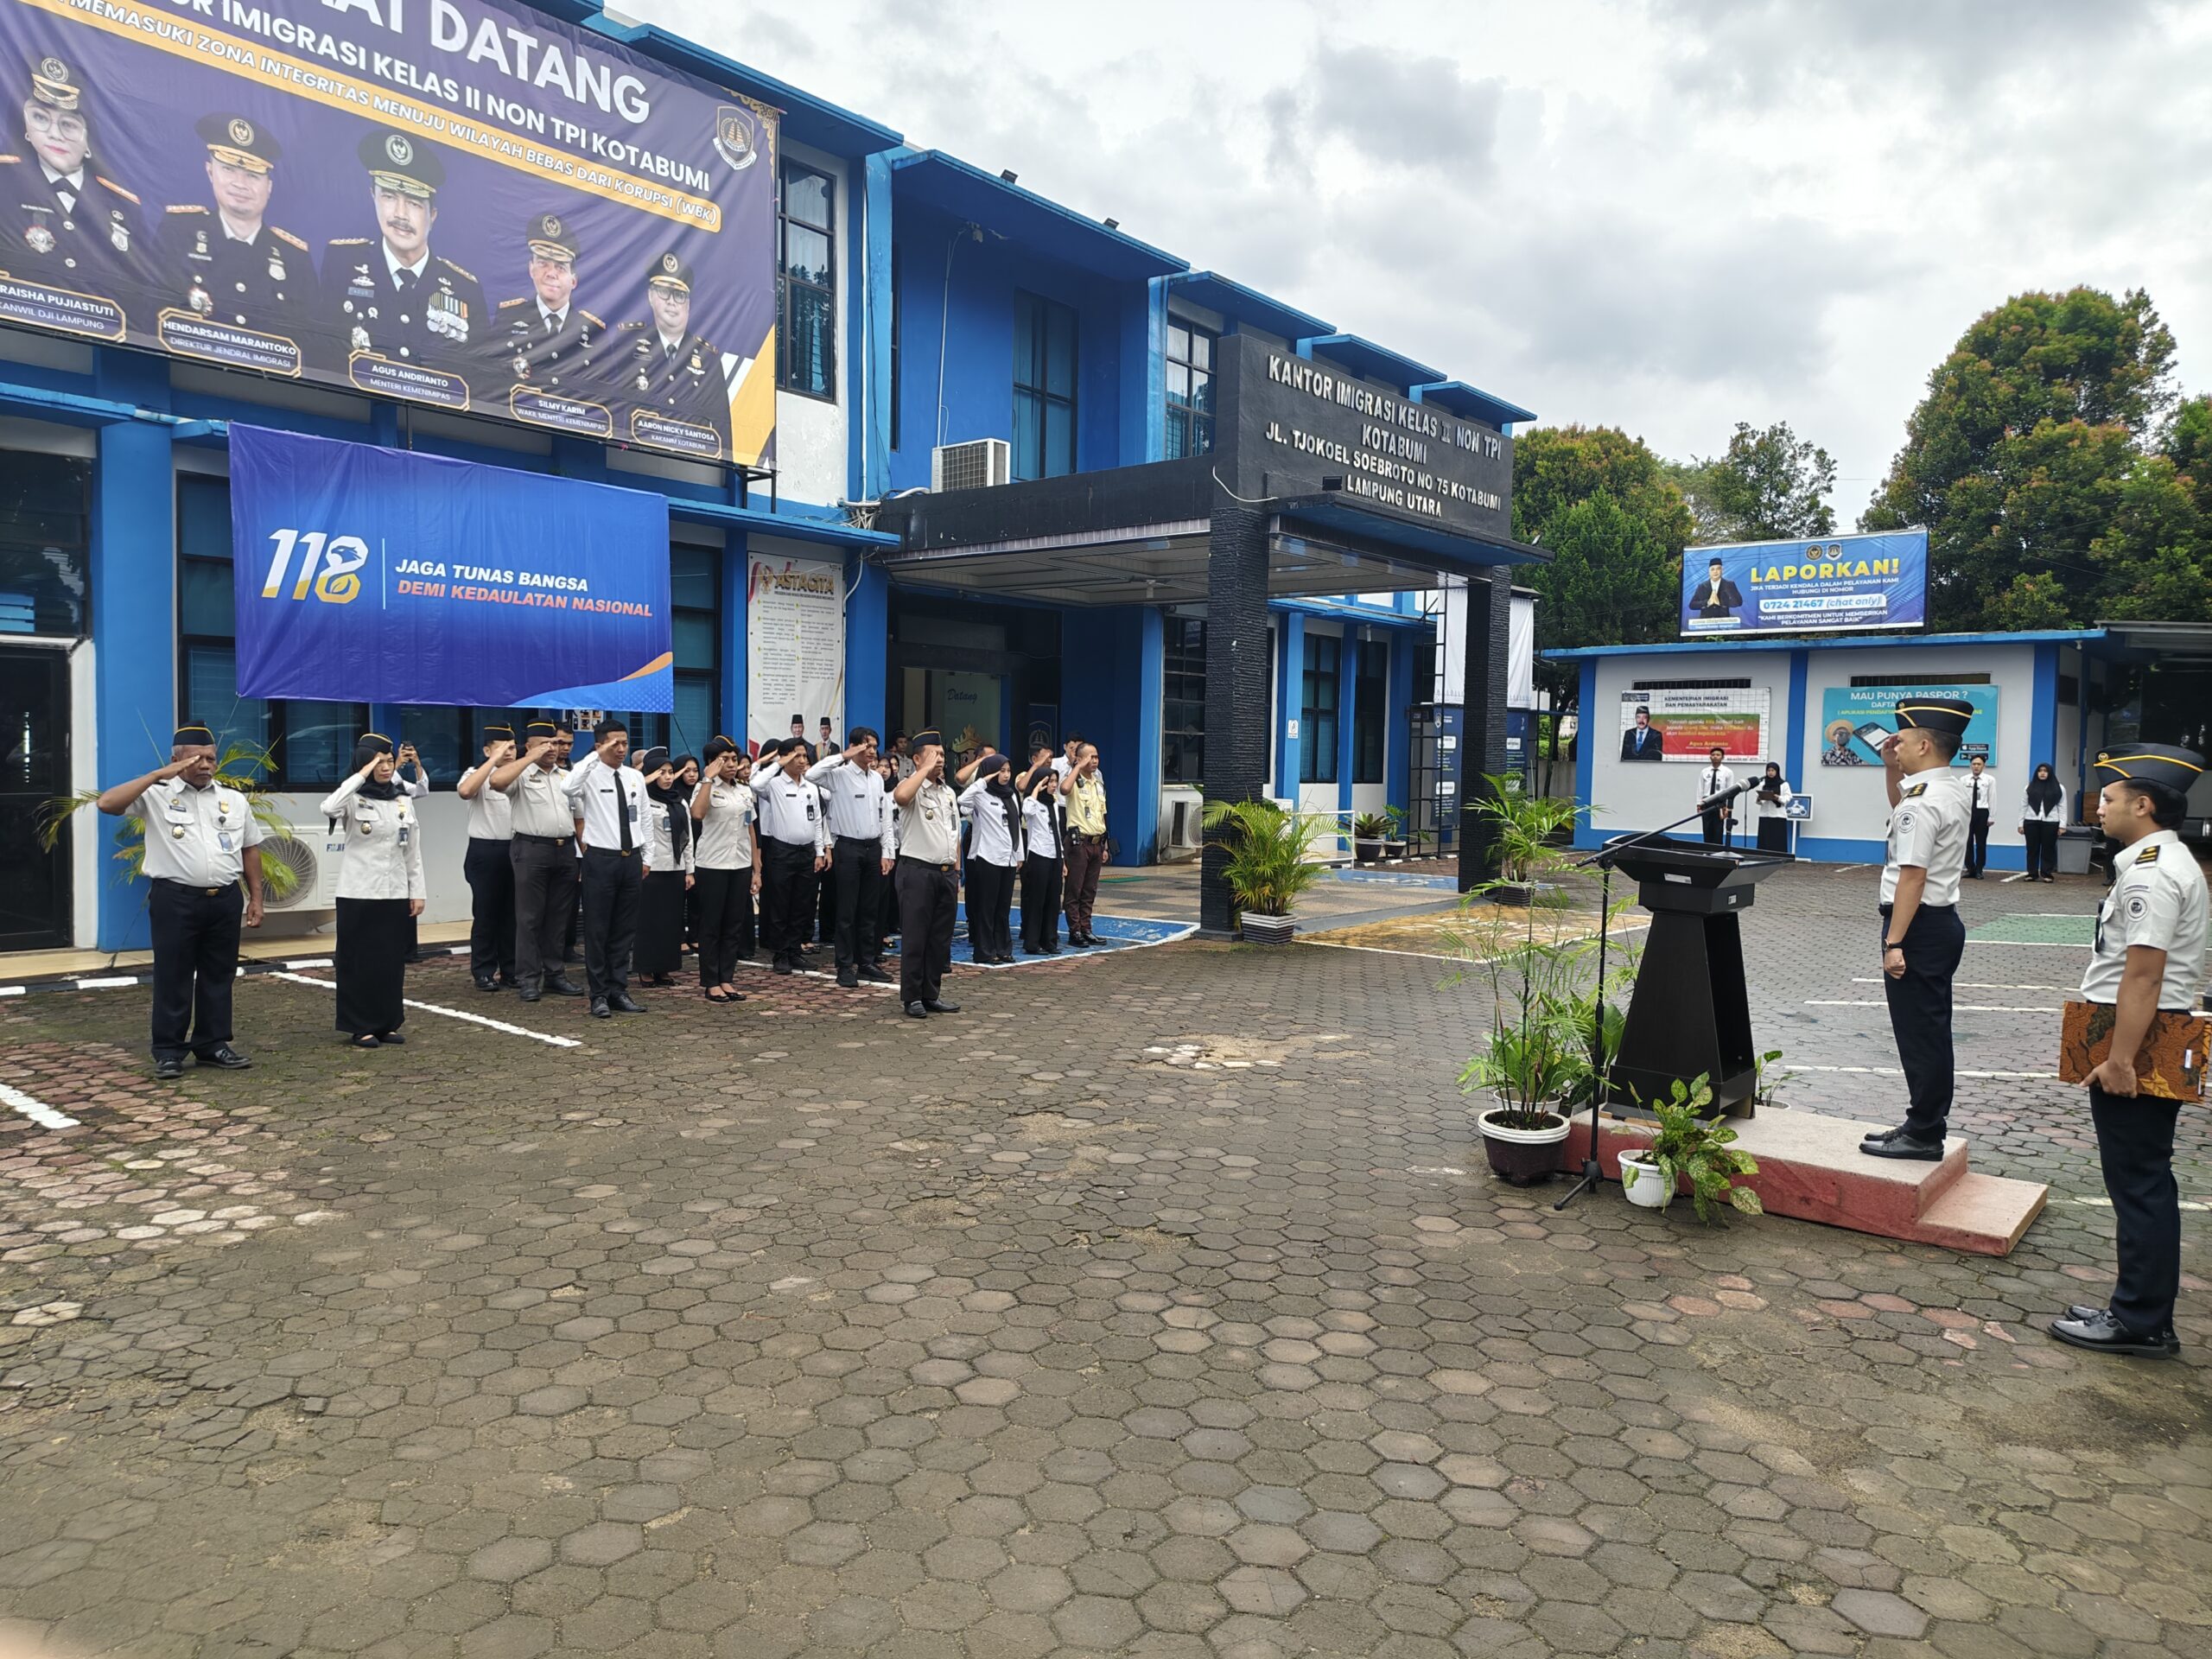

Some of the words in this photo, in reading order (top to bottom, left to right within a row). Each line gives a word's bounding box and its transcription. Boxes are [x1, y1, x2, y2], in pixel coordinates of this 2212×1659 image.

[430, 0, 650, 124] DATANG
[222, 0, 367, 70] IMIGRASI
[373, 51, 460, 103] KELAS
[466, 86, 480, 111] II
[487, 93, 545, 135] NON
[550, 117, 587, 149] TPI
[592, 132, 710, 192] KOTABUMI
[69, 0, 193, 46] MEMASUKI
[197, 34, 257, 68] ZONA
[260, 55, 370, 106] INTEGRITAS
[372, 95, 447, 130] MENUJU
[448, 121, 523, 159] WILAYAH
[525, 147, 575, 175] BEBAS
[576, 165, 612, 188] DARI
[614, 178, 673, 208] KORUPSI
[676, 197, 718, 226] (WBK)
[0, 284, 46, 302] RAISHA
[48, 295, 114, 316] PUJIASTUTI
[38, 308, 54, 321] DJI
[55, 313, 105, 330] LAMPUNG
[163, 321, 230, 341] HENDARSAM
[230, 334, 296, 355] MARANTOKO
[169, 337, 213, 352] DIREKTUR
[213, 346, 251, 360] JENDRAL
[252, 354, 290, 368] IMIGRASI
[370, 378, 402, 391] MENTERI
[372, 365, 397, 377] AGUS
[397, 370, 449, 387] ANDRIANTO
[537, 399, 560, 410] SILMY
[561, 404, 586, 415] KARIM
[538, 412, 565, 423] MENTERI
[1268, 354, 1332, 401] KANTOR
[1336, 380, 1395, 423] IMIGRASI
[1397, 404, 1437, 437] KELAS
[1456, 425, 1480, 454] NON
[1484, 435, 1502, 461] TPI
[638, 420, 663, 431] AARON
[663, 424, 684, 435] NICKY
[684, 429, 715, 442] SANTOSA
[677, 438, 707, 450] KOTABUMI
[1362, 423, 1427, 465] KOTABUMI
[1265, 422, 1287, 445] JL.
[1293, 429, 1350, 465] TJOKOEL
[1353, 451, 1414, 486] SOEBROTO
[1417, 473, 1433, 491] NO
[1437, 476, 1449, 495] 75
[1451, 481, 1502, 512] KOTABUMI
[1347, 474, 1403, 507] LAMPUNG
[1407, 492, 1442, 518] UTARA
[261, 528, 369, 604] 118
[395, 558, 447, 577] JAGA
[452, 564, 514, 584] TUNAS
[518, 572, 589, 592] BANGSA
[1751, 557, 1900, 583] LAPORKAN!
[1843, 578, 1881, 587] PELAYANAN
[397, 580, 445, 598] DEMI
[451, 584, 567, 609] KEDAULATAN
[571, 596, 653, 618] NASIONAL
[1764, 600, 1789, 609] 0724
[1792, 599, 1824, 608] 21467
[1826, 598, 1854, 608] (chat
[1855, 595, 1881, 607] only)
[1850, 692, 1875, 701] MAU
[1877, 691, 1913, 700] PUNYA
[1915, 690, 1961, 699] PASPOR
